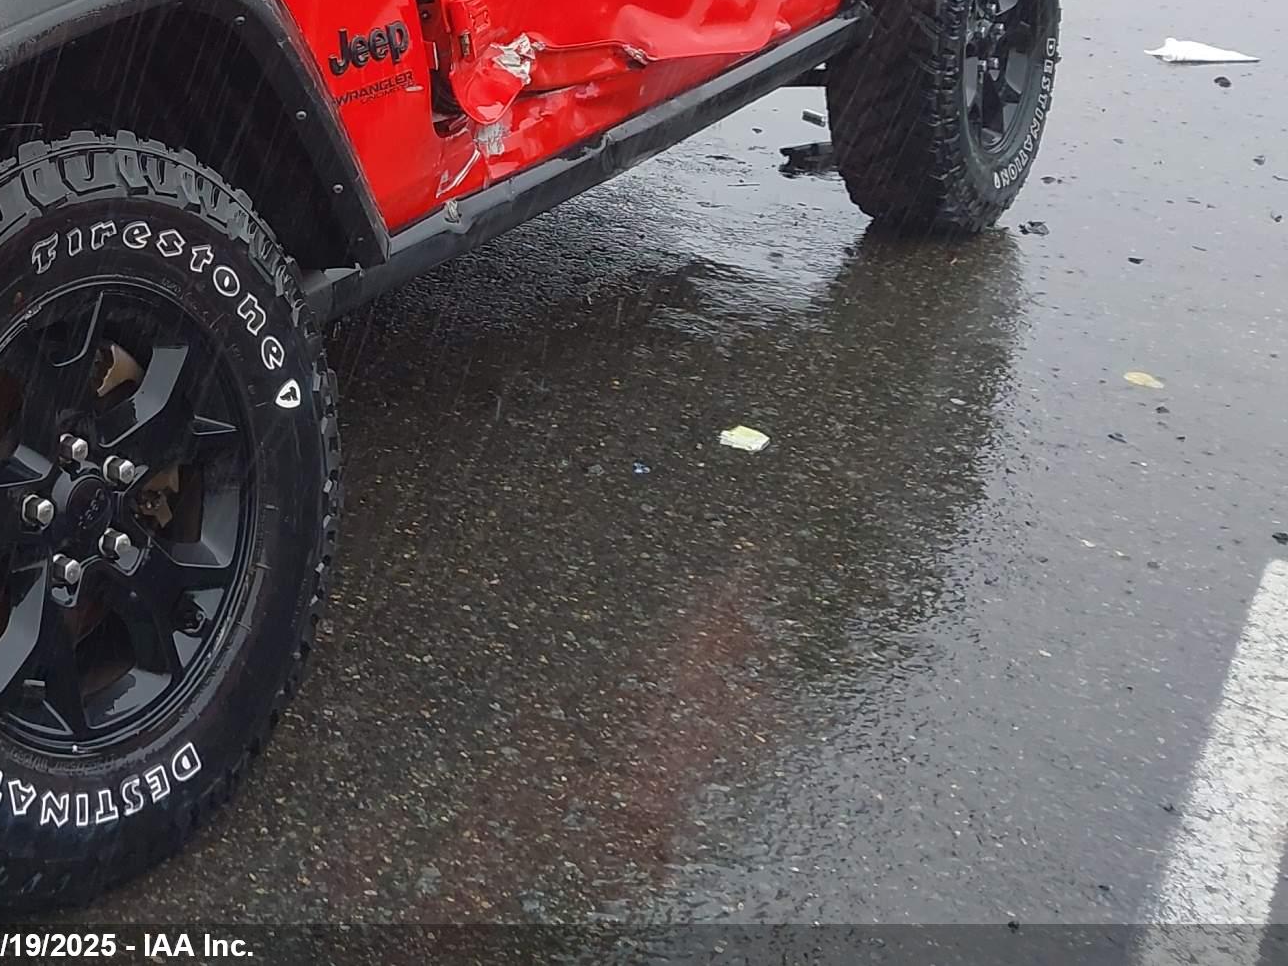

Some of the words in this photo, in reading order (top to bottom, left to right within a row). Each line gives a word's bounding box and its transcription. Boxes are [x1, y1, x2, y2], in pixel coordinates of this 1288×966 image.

[328, 19, 410, 76] Jeep
[332, 70, 414, 106] WRANGLER
[999, 37, 1057, 187] DESTINATION
[31, 220, 285, 370] Firestone
